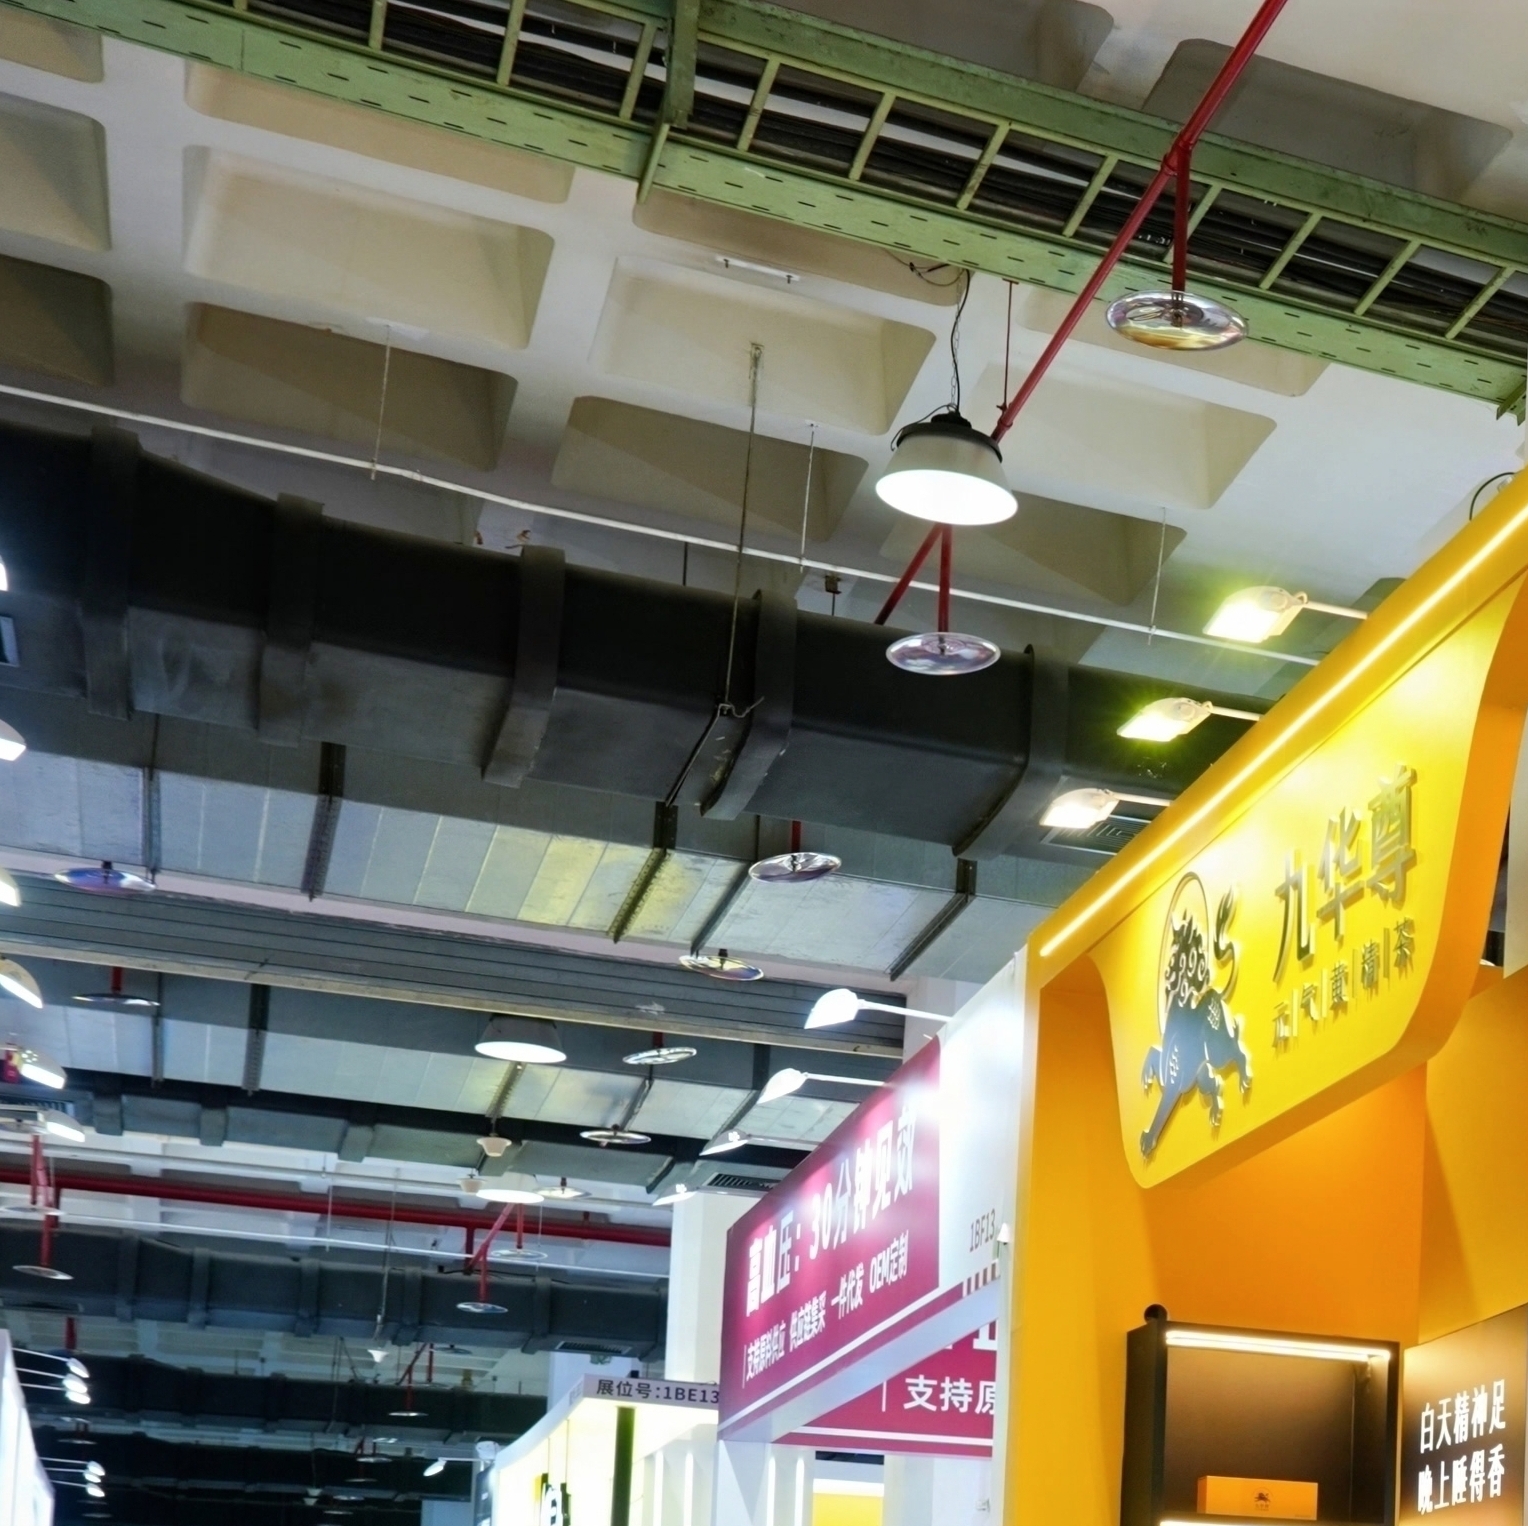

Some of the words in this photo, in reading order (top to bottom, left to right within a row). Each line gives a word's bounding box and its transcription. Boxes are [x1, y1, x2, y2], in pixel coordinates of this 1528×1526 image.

[1272, 762, 1417, 983] 九华尊
[831, 1263, 864, 1320] 一件代发
[869, 1230, 908, 1294] OEM定制
[1420, 1379, 1506, 1454] 白天精神足
[1418, 1443, 1505, 1515] 晚上睡得香
